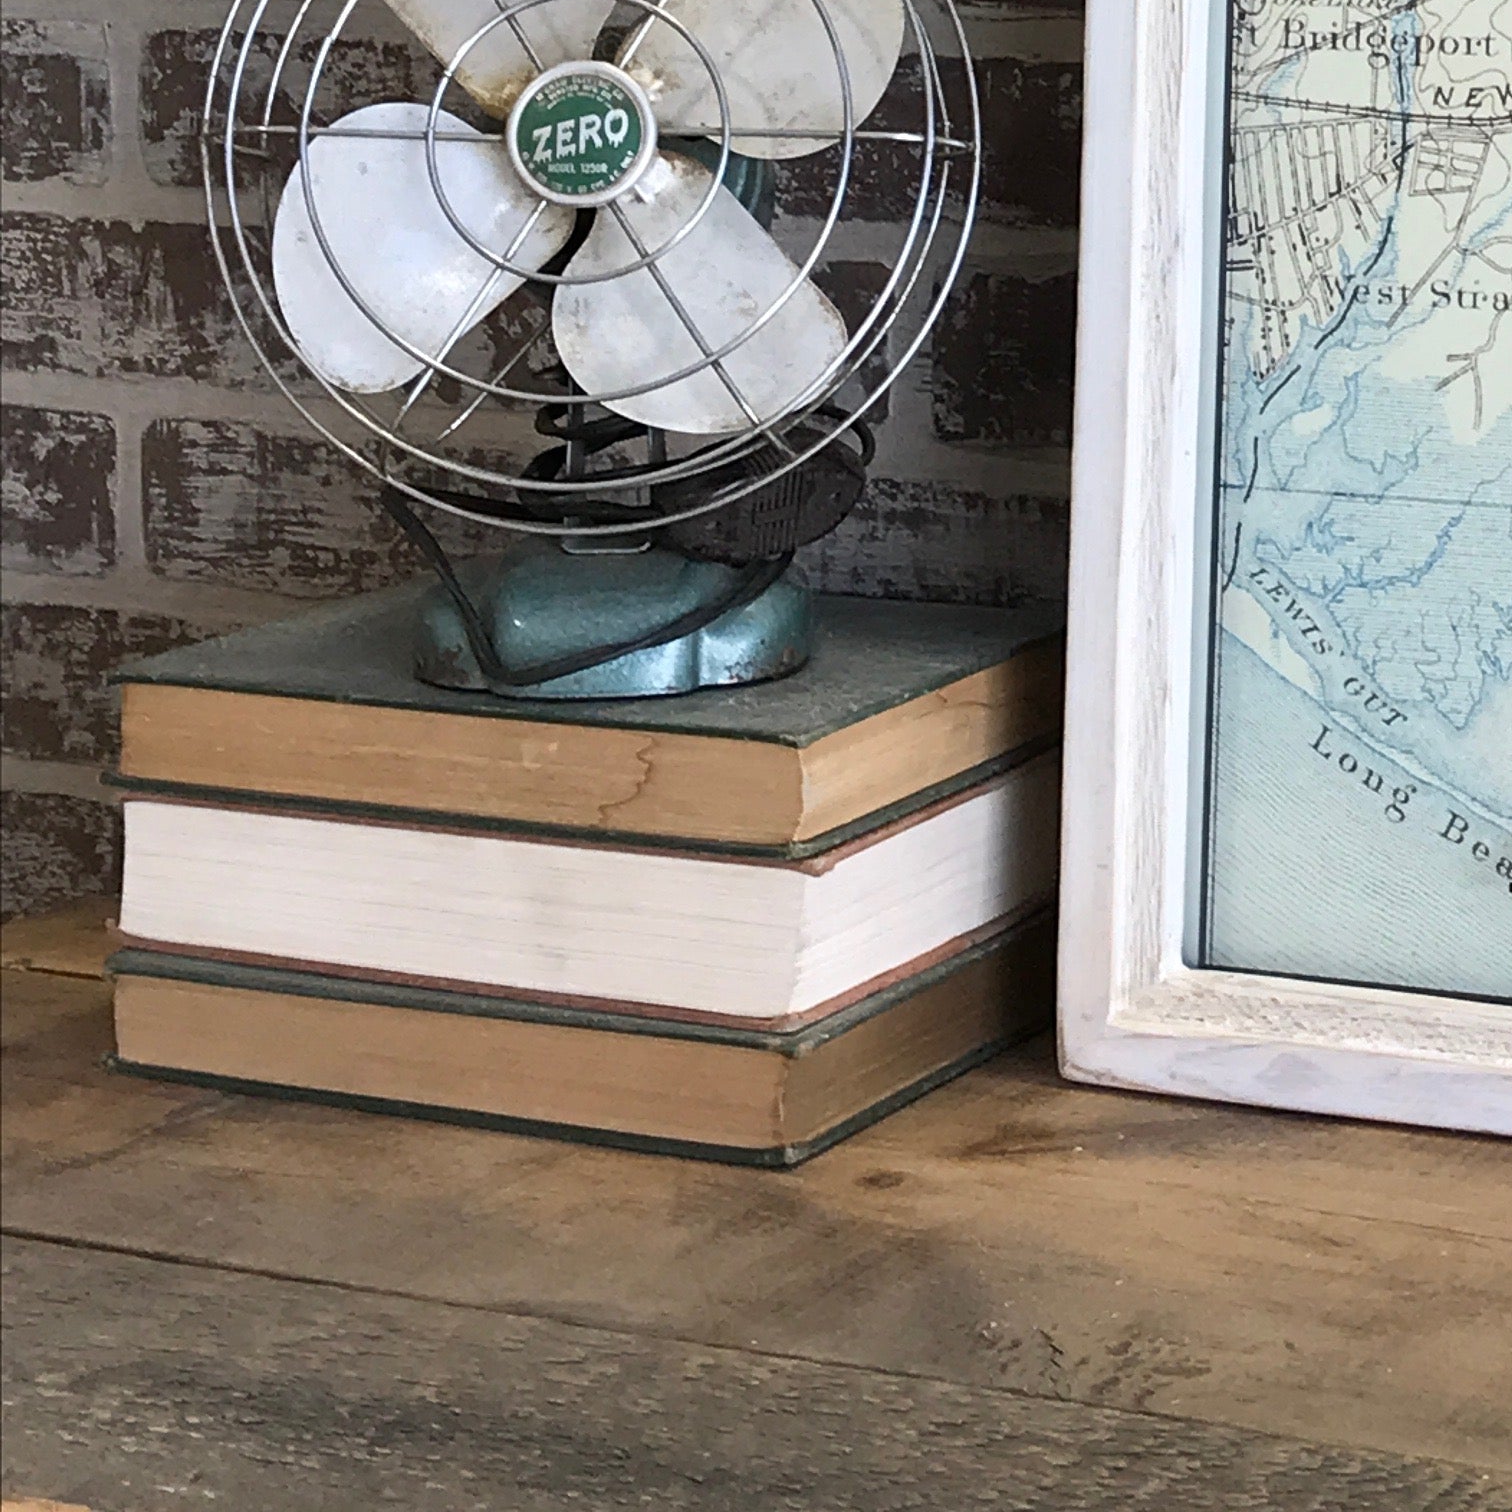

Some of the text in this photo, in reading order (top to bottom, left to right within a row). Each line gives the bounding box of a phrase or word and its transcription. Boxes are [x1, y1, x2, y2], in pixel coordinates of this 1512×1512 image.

[1281, 18, 1500, 70] Bridgeport
[532, 107, 629, 165] ZERO
[1343, 676, 1409, 728] GUT
[1310, 723, 1418, 825] Long
